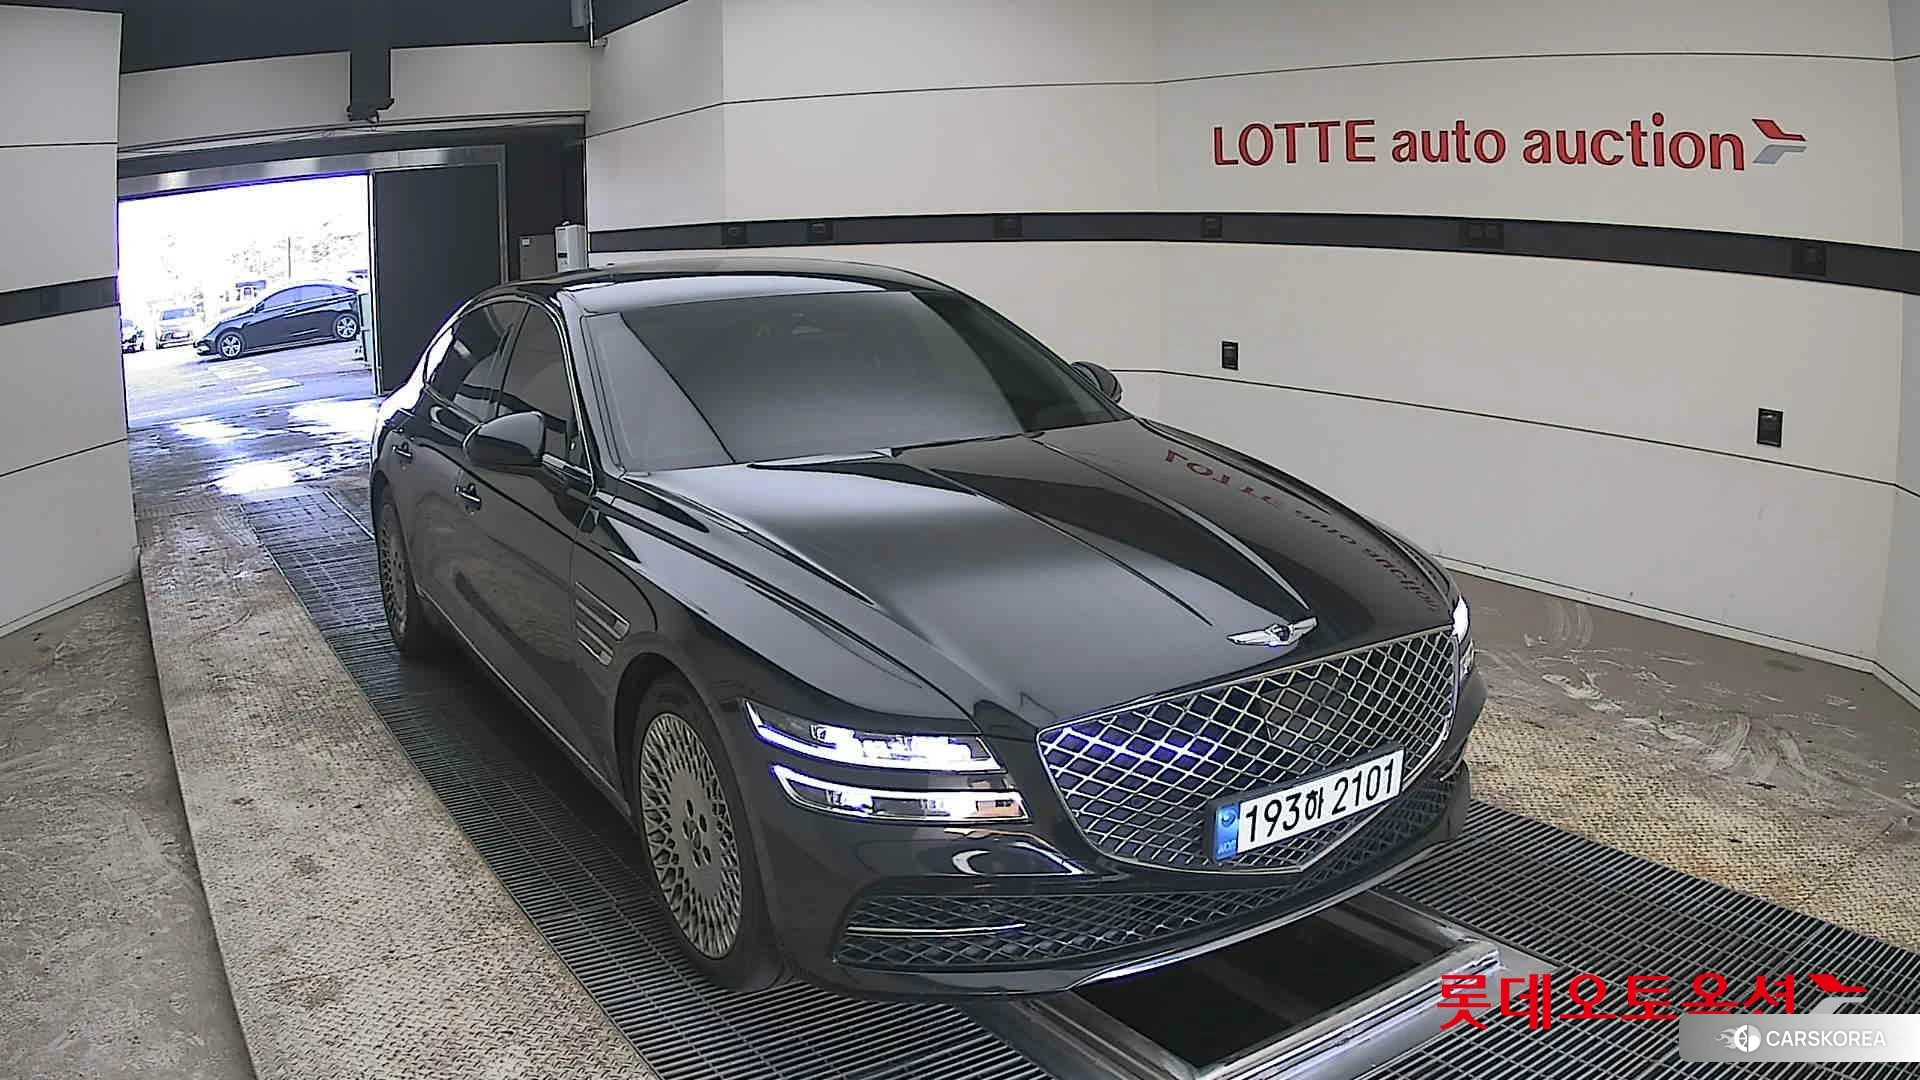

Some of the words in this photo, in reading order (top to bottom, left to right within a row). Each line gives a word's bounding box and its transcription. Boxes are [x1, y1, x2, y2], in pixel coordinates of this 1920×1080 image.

[1213, 119, 1376, 166] LOTTE
[1391, 120, 1506, 164] auto
[1522, 112, 1745, 171] auction
[1245, 786, 1324, 842] 193하
[1331, 758, 1395, 815] 2101
